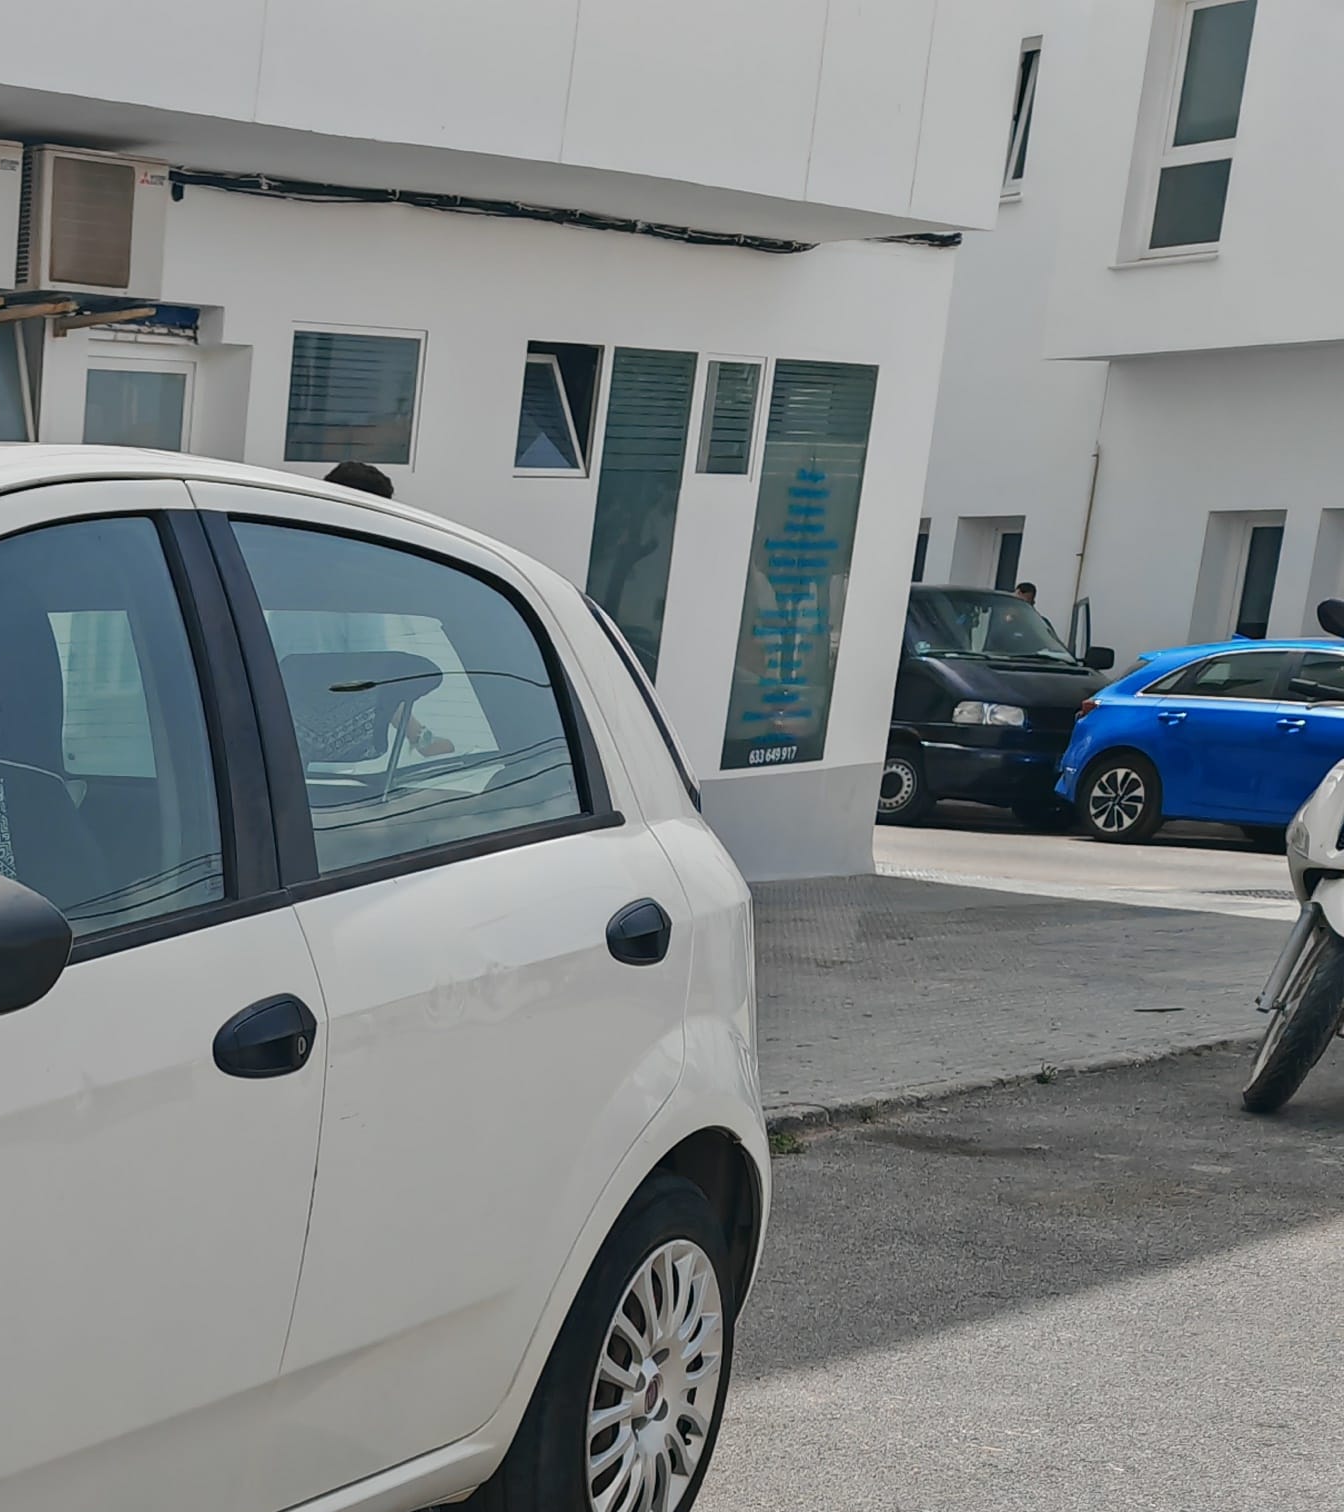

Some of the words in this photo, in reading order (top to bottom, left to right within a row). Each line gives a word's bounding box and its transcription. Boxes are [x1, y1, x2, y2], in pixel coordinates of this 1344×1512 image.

[749, 749, 765, 764] 633
[765, 747, 781, 762] 649
[782, 745, 797, 760] 917
